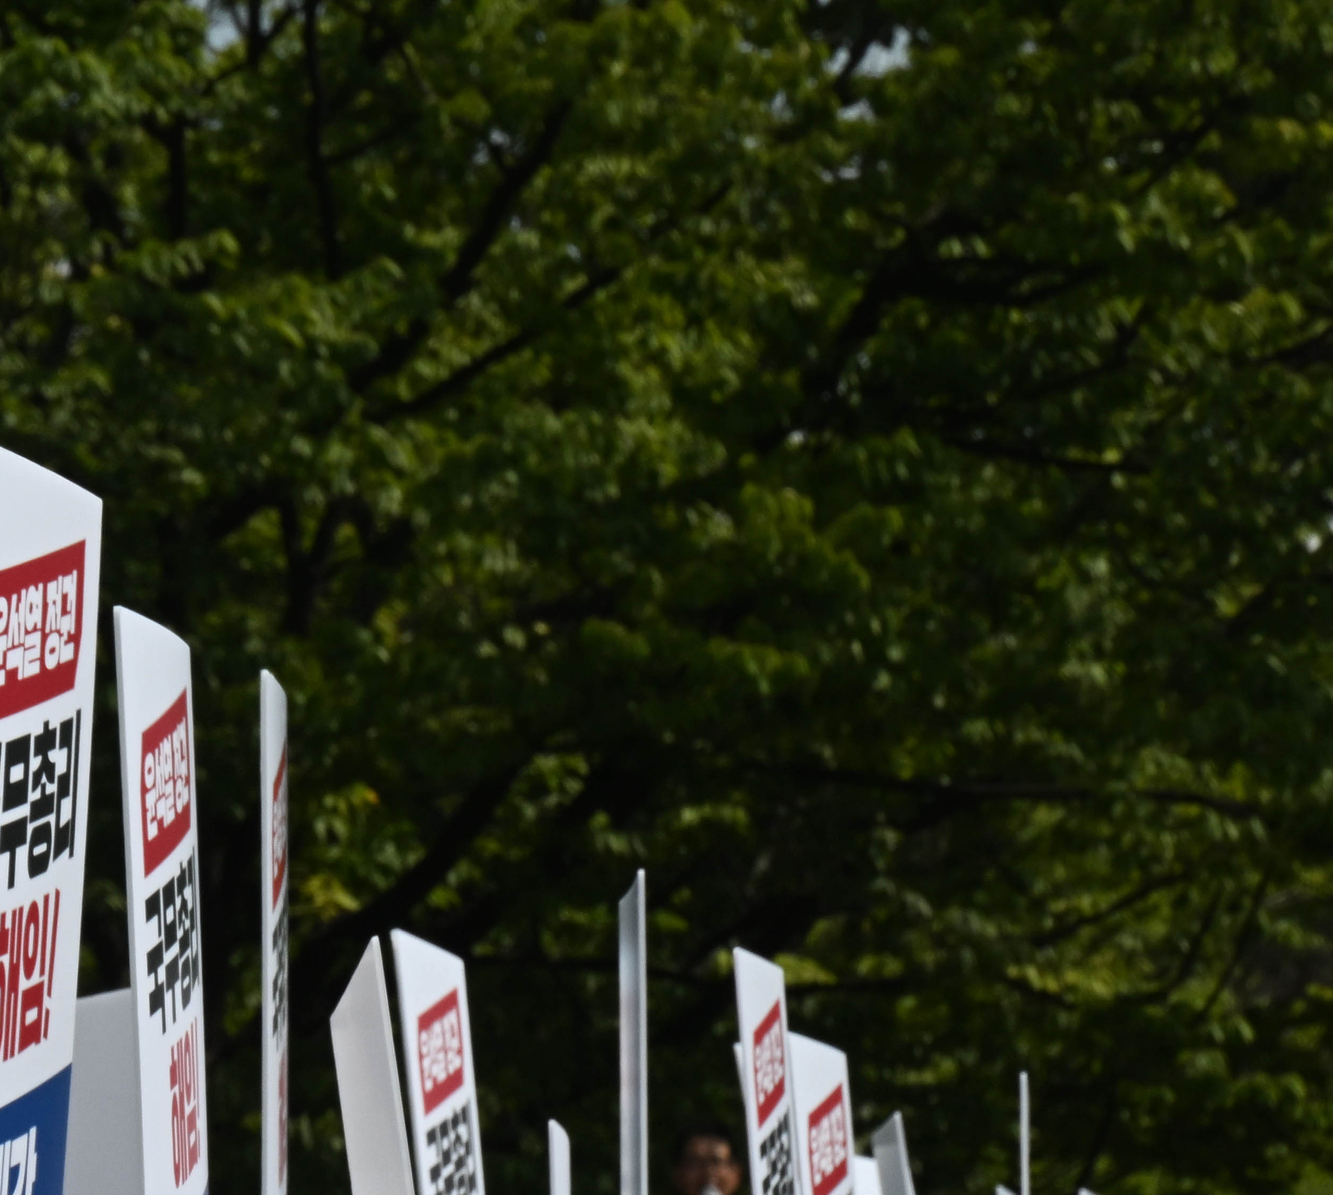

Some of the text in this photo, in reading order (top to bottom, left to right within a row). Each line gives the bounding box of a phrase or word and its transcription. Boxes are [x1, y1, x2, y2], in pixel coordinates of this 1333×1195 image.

[43, 567, 76, 671] 정권
[145, 846, 200, 1036] 국무총리
[169, 1016, 202, 1190] 해임!
